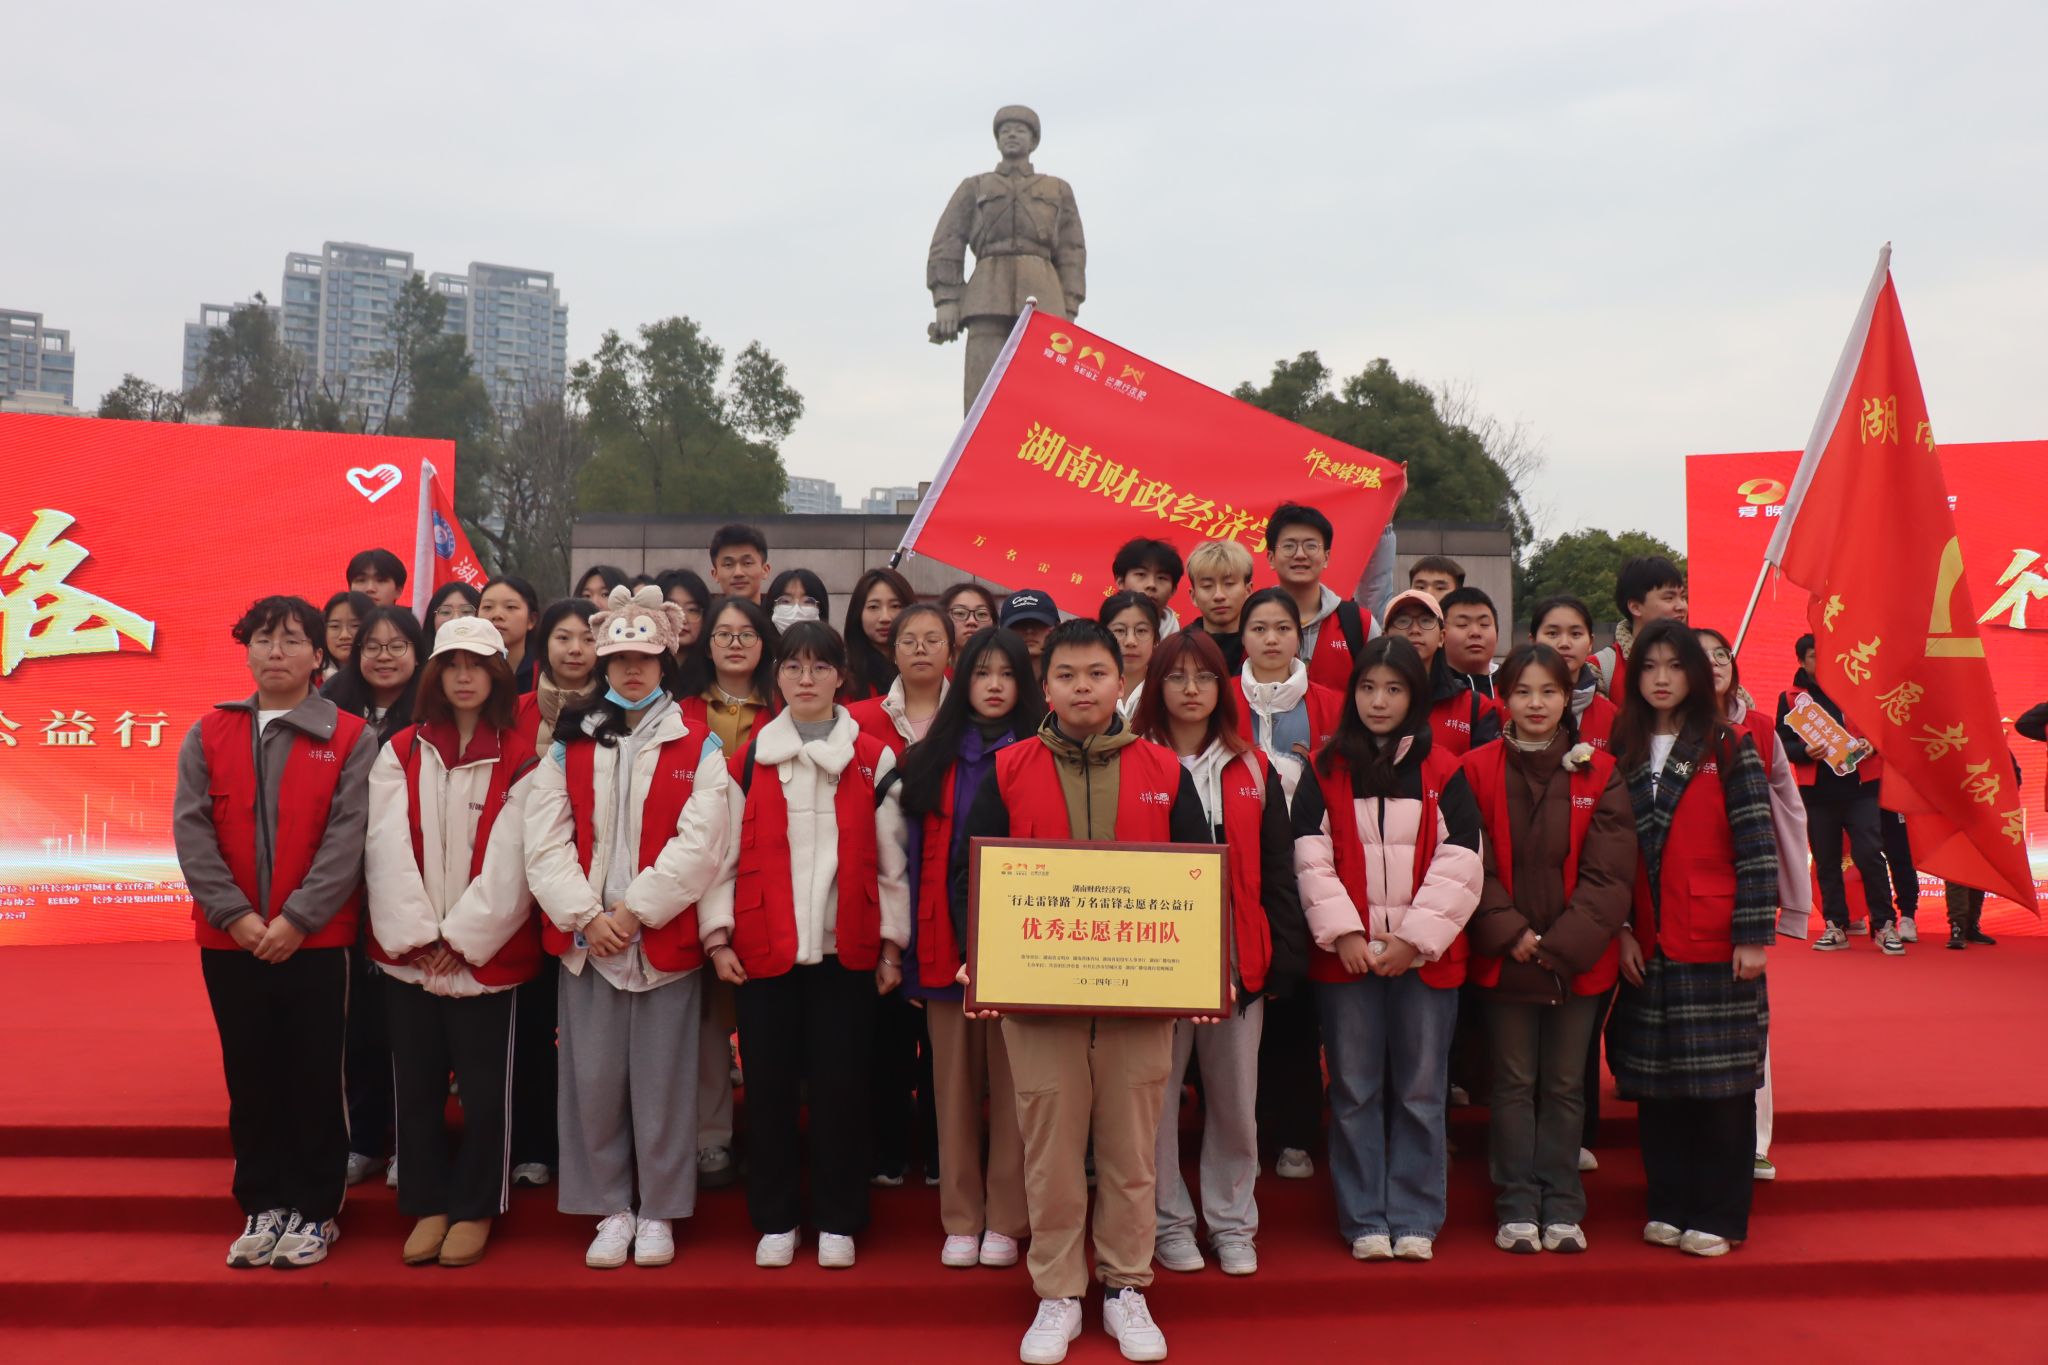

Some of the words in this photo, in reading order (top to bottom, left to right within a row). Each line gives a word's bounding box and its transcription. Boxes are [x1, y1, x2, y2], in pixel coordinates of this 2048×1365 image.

[1021, 917, 1181, 944] 优秀志愿者团队
